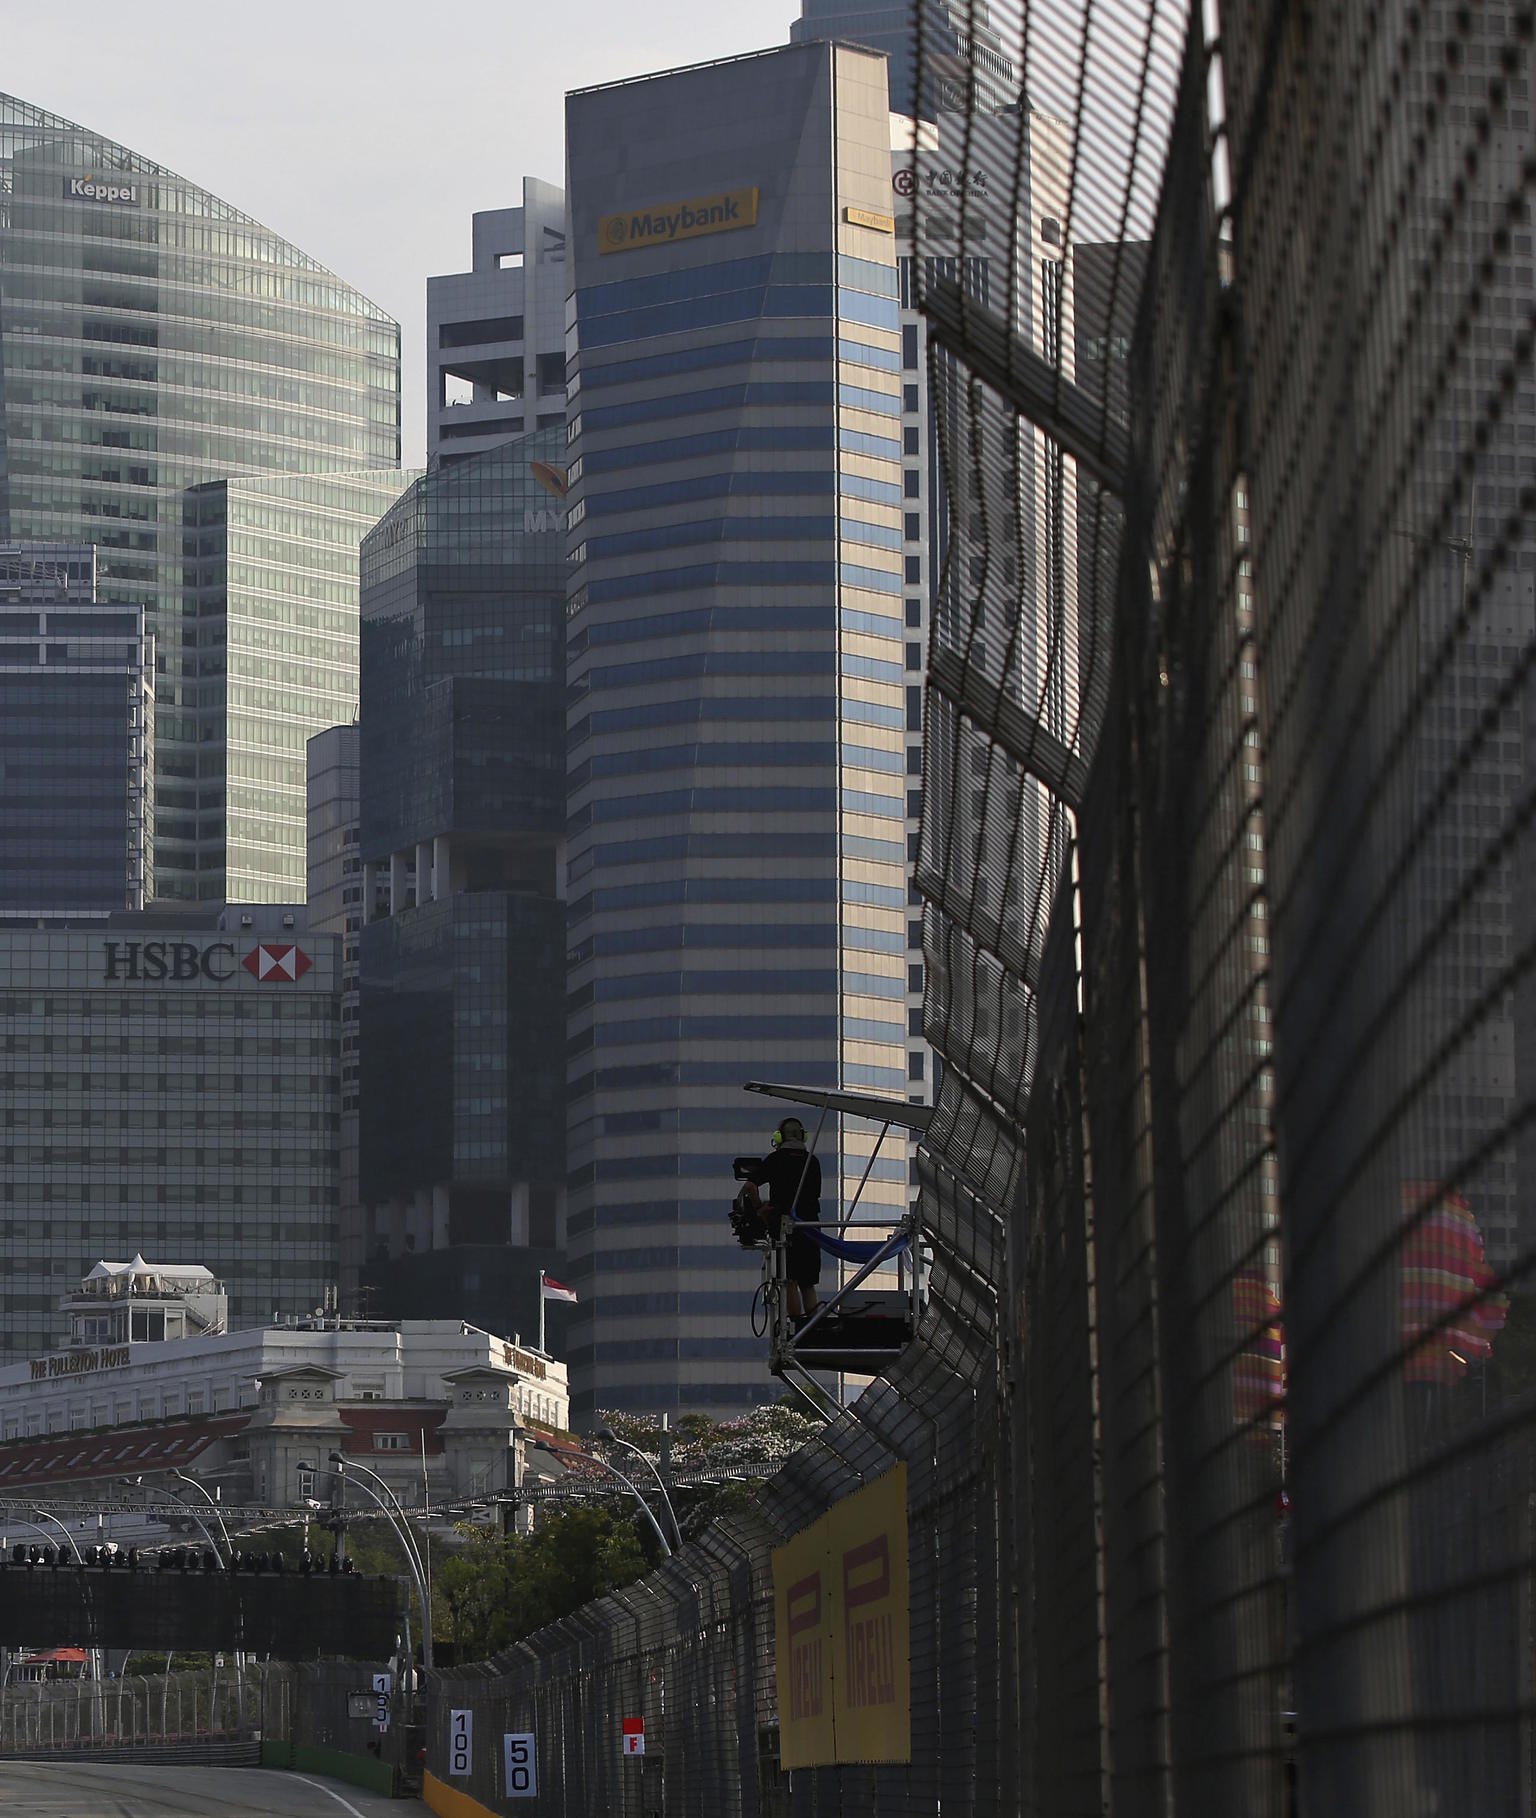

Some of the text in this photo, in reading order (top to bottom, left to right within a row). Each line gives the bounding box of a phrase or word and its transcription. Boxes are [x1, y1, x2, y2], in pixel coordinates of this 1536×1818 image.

[71, 178, 136, 202] Keppel
[630, 196, 739, 239] Maybank
[103, 941, 236, 982] HSBC
[29, 1347, 130, 1380] THE FULLERTON HOTEL
[842, 1532, 897, 1709] PIRELLI
[787, 1568, 824, 1722] PIRELLI
[454, 1714, 467, 1771] 100
[629, 1737, 638, 1752] F
[511, 1740, 529, 1791] 50
